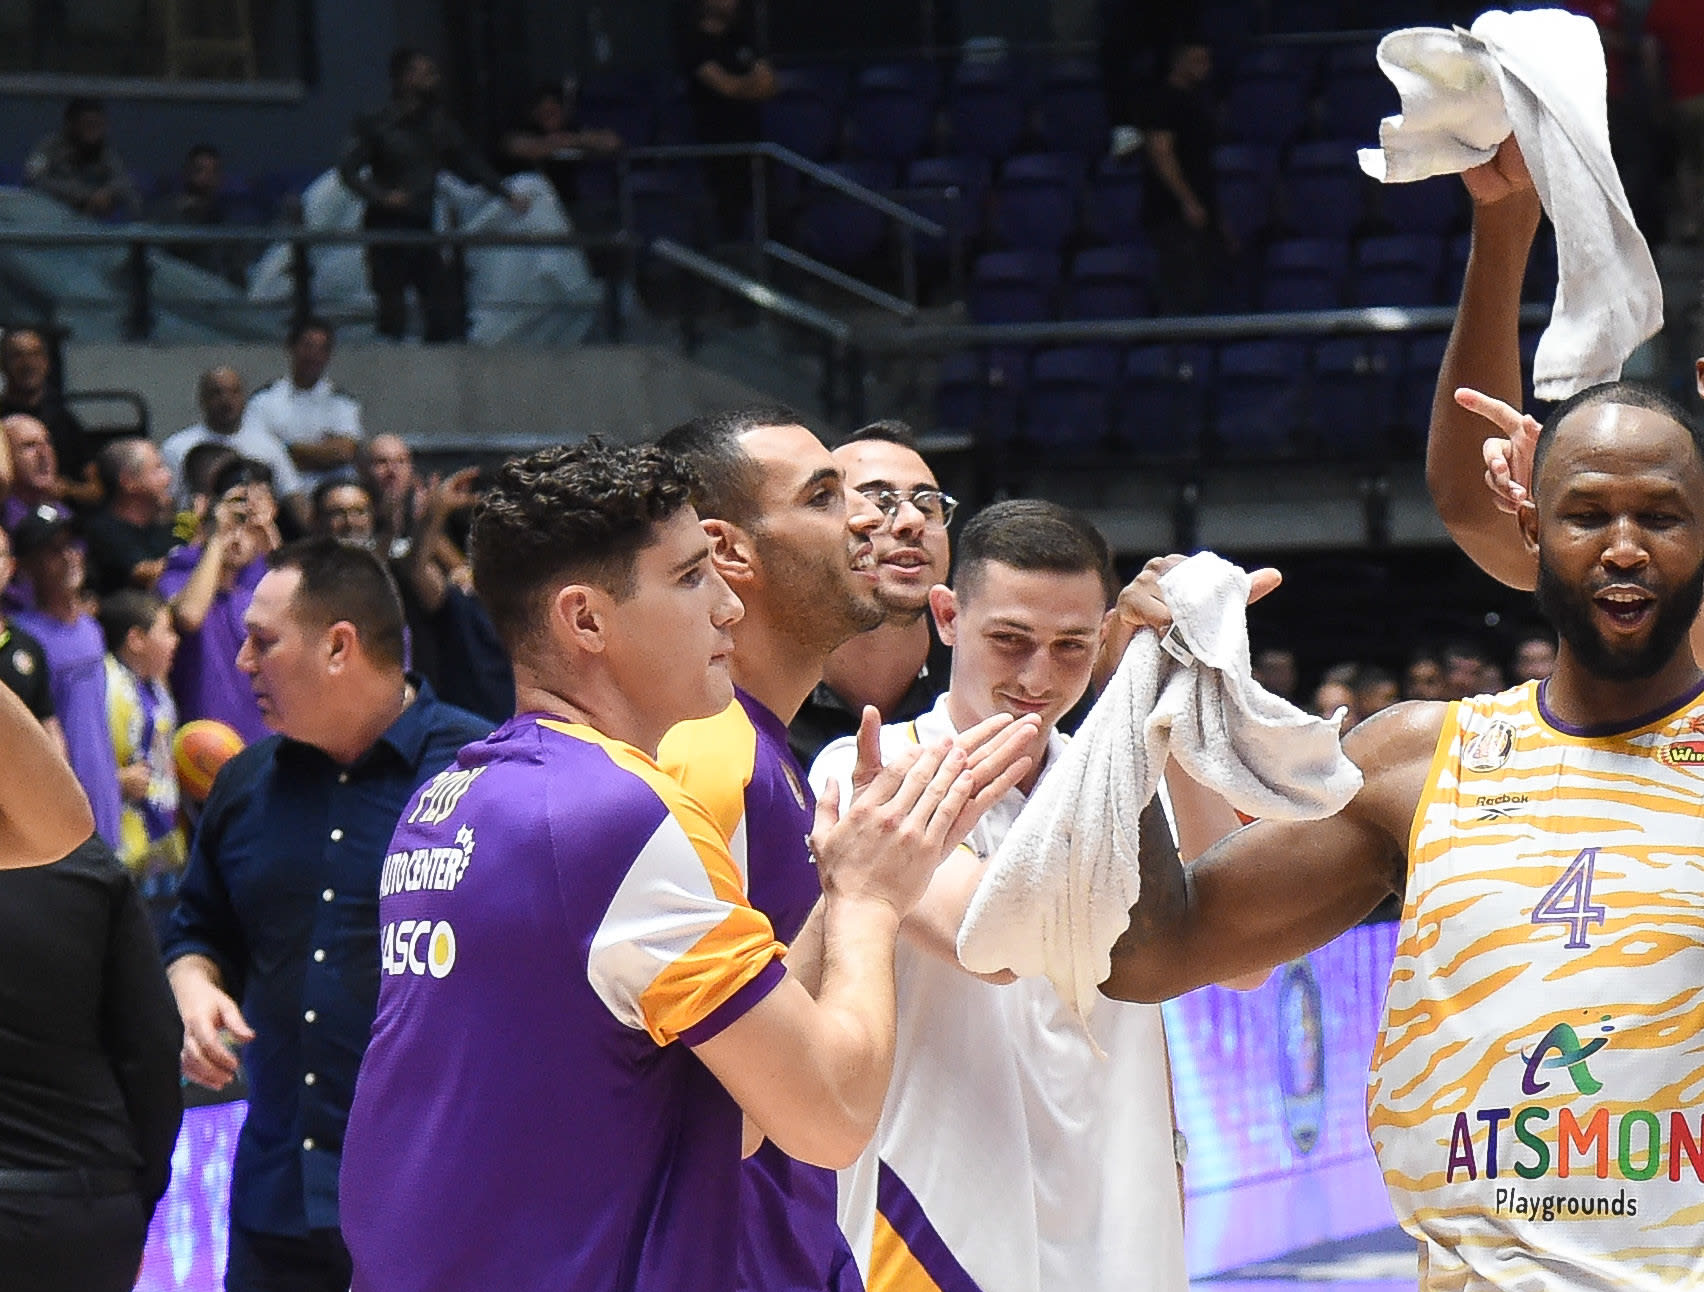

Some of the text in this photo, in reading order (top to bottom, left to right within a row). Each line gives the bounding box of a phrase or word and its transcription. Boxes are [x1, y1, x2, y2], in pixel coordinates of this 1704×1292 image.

[1475, 793, 1529, 807] Reebok
[1531, 847, 1606, 950] 4
[1495, 1187, 1639, 1222] Playgrounds
